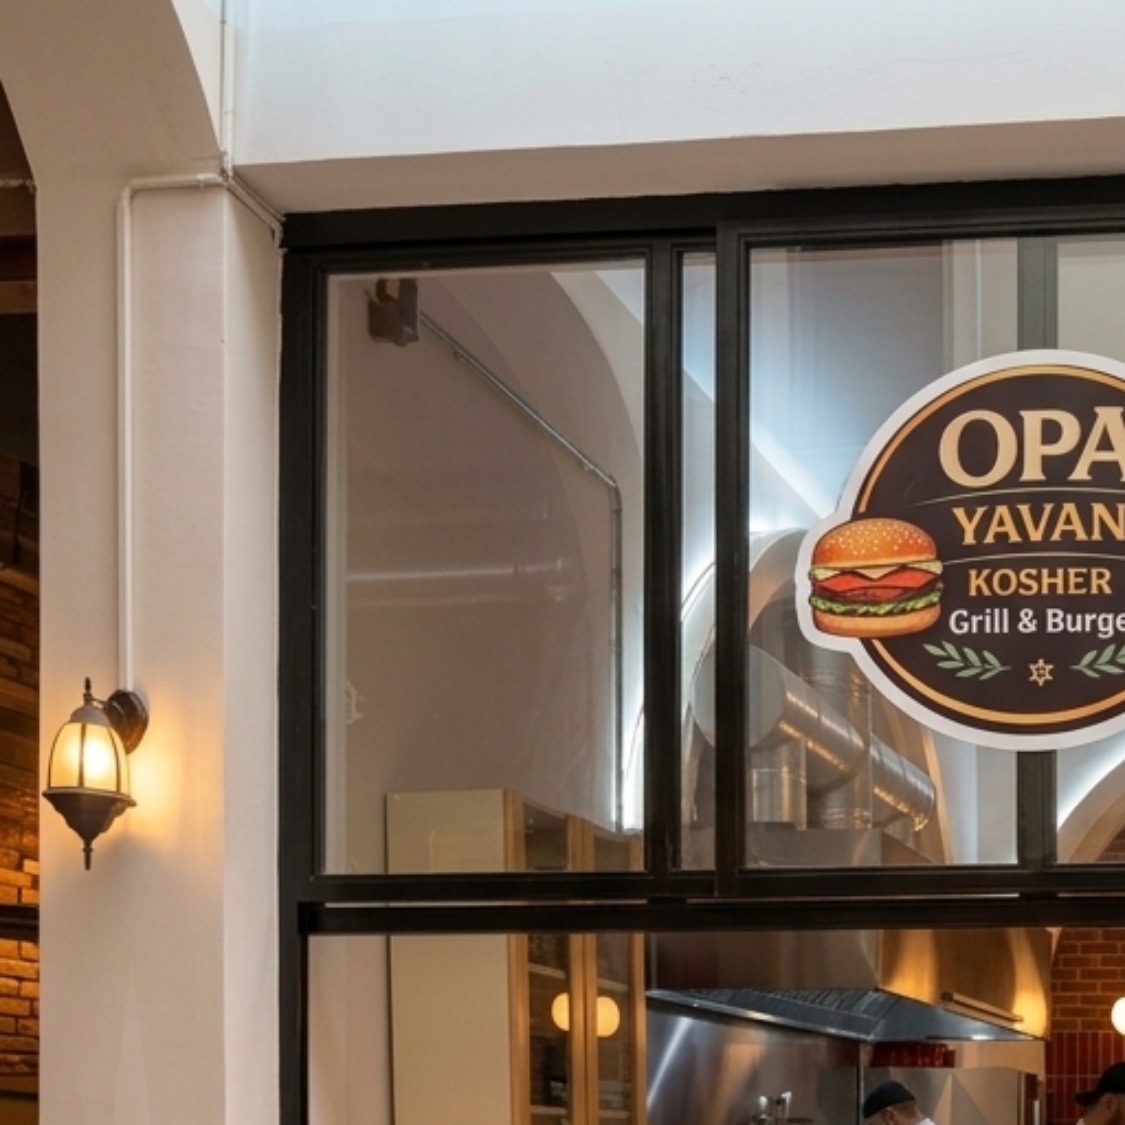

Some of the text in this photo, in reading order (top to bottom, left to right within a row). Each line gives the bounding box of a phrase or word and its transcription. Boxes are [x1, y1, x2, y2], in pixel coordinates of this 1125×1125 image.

[968, 567, 1113, 597] KOSHER
[948, 607, 1010, 635] Grill
[1017, 607, 1038, 634] &
